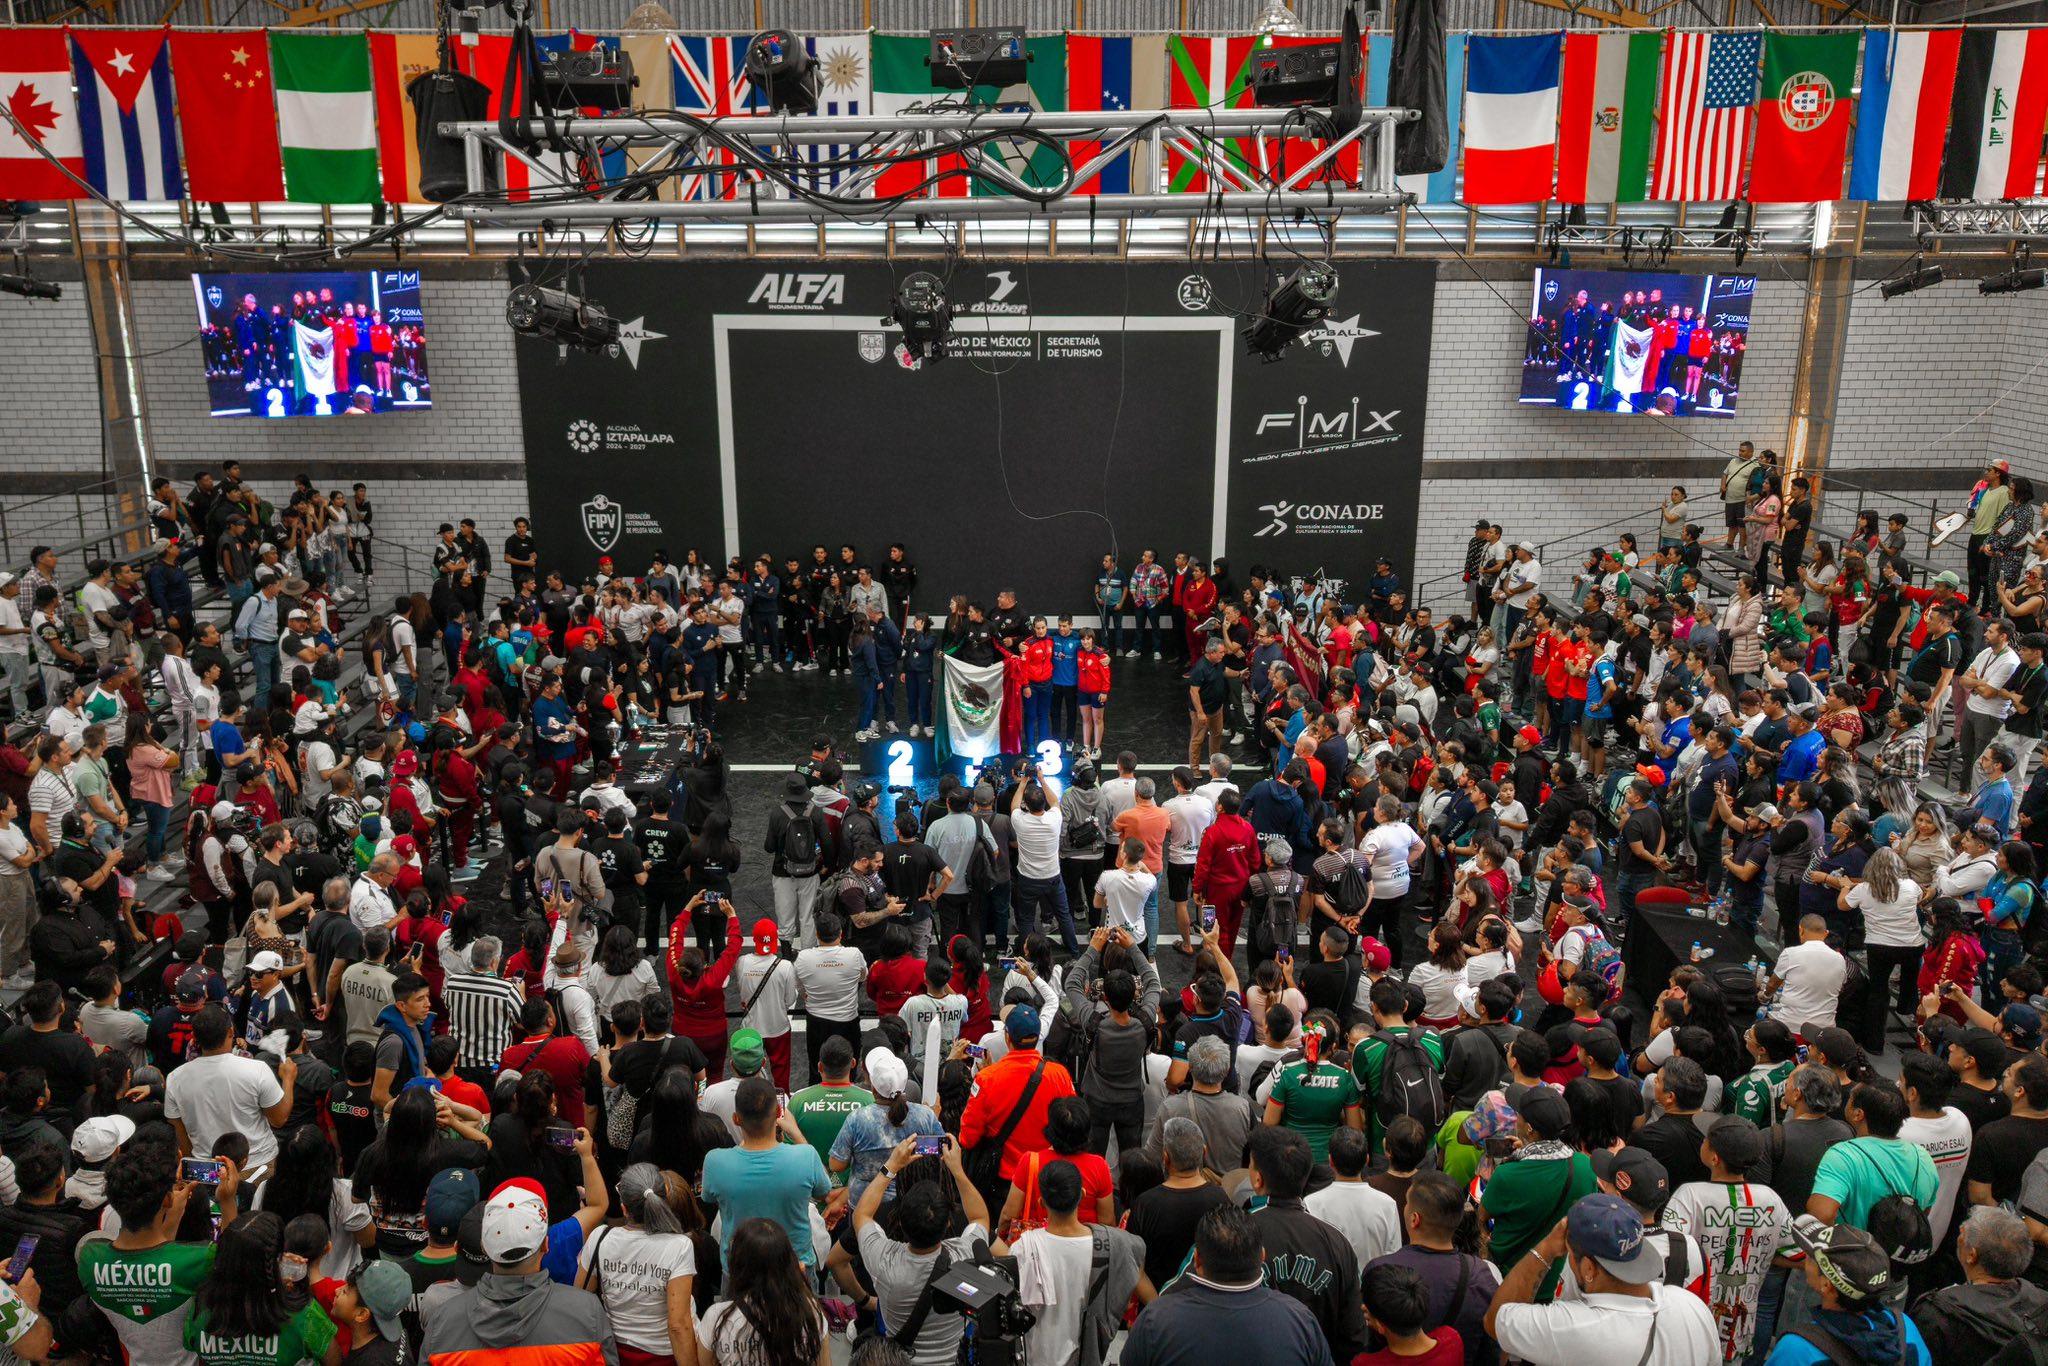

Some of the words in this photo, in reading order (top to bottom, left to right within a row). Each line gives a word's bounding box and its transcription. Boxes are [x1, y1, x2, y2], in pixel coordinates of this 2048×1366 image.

[748, 273, 845, 304] ALFA
[972, 337, 987, 347] DE
[990, 335, 1031, 347] MÉXICO
[1047, 335, 1101, 346] SECRETARÍA
[1047, 349, 1060, 357] DE
[1061, 349, 1102, 357] TURISMO
[267, 388, 286, 417] 2
[1571, 382, 1590, 409] 2
[606, 432, 675, 443] IZTAPALAPA
[1296, 504, 1384, 520] CONADE
[588, 513, 616, 529] FIPV
[887, 740, 914, 776] 2
[1035, 739, 1062, 776] 3
[645, 829, 668, 838] CREW
[345, 979, 383, 1003] BRASIL
[803, 1099, 861, 1112] MÉXICO
[1704, 1205, 1775, 1228] MEX
[93, 1260, 172, 1287] MÉXICO
[603, 1258, 628, 1274] Ruta
[631, 1261, 648, 1276] del
[1868, 1270, 1888, 1286] 46
